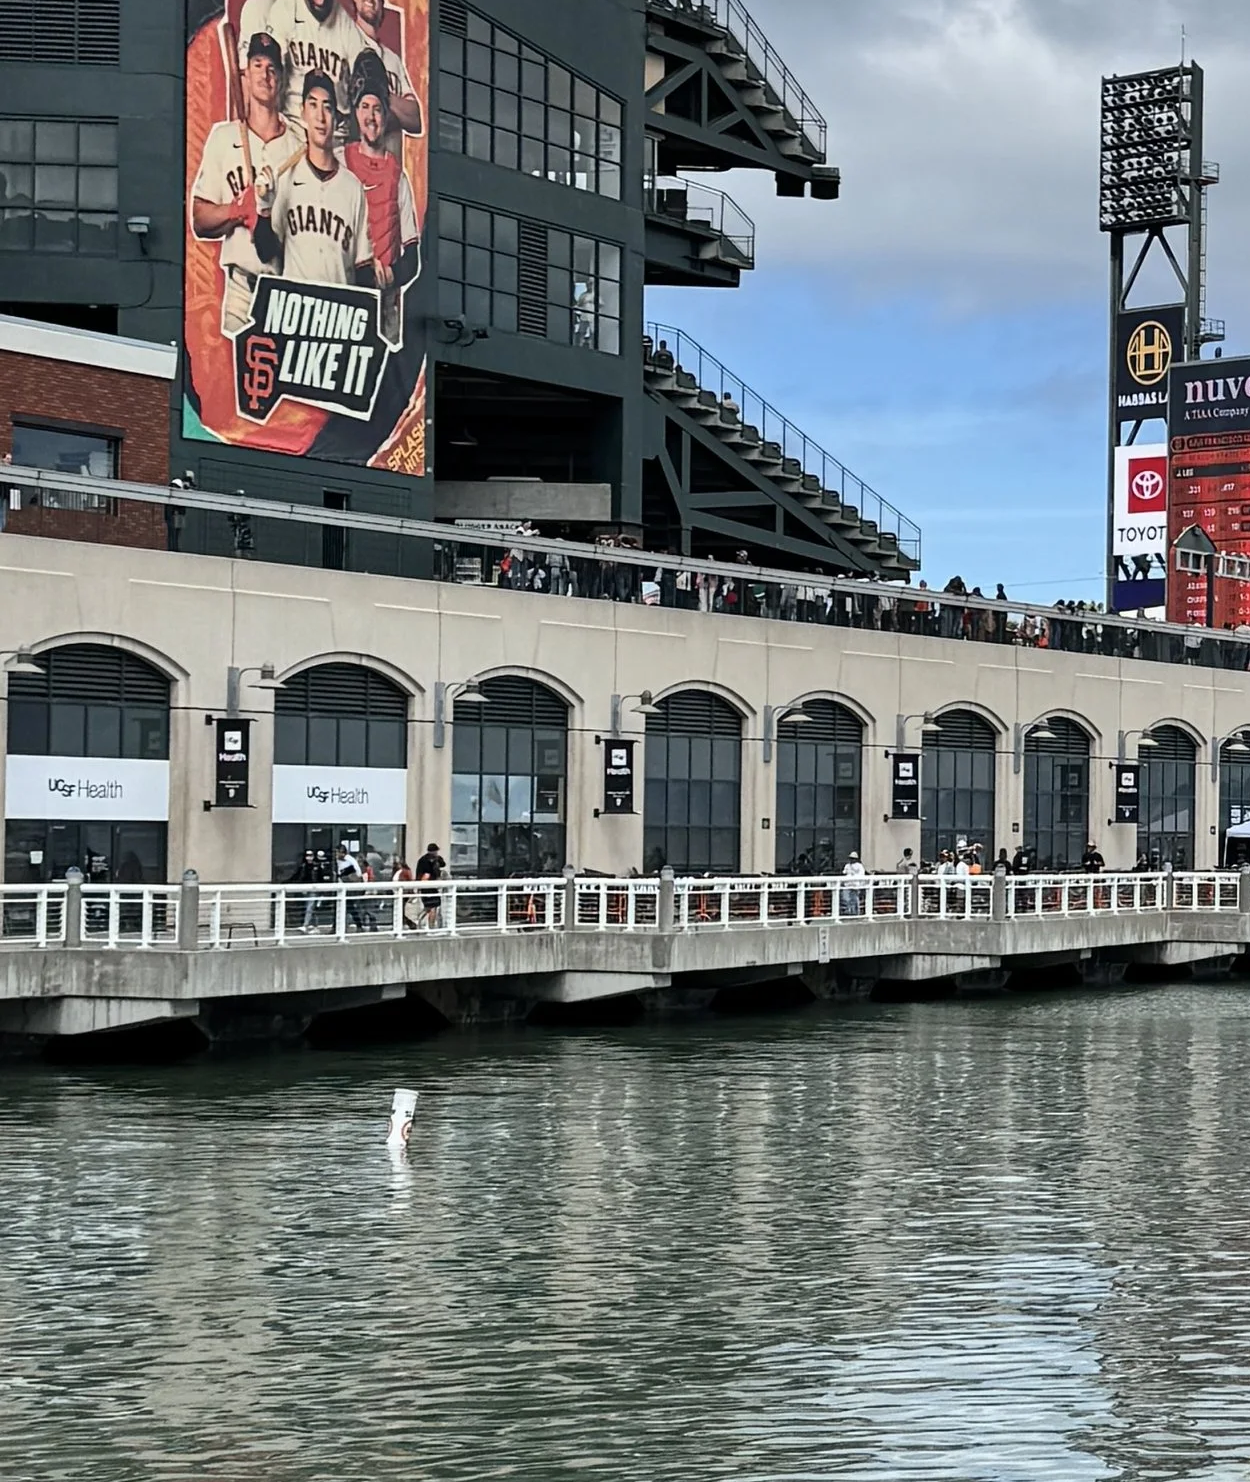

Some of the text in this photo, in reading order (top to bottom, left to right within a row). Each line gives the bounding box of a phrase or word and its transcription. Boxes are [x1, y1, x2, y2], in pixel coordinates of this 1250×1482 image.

[287, 205, 353, 252] GIANTS
[263, 288, 369, 342] NOTHING
[278, 339, 374, 396] LIKE IT
[1118, 525, 1166, 543] TOYOT
[48, 778, 123, 799] UCSF Health
[306, 785, 369, 805] UCSF Health
